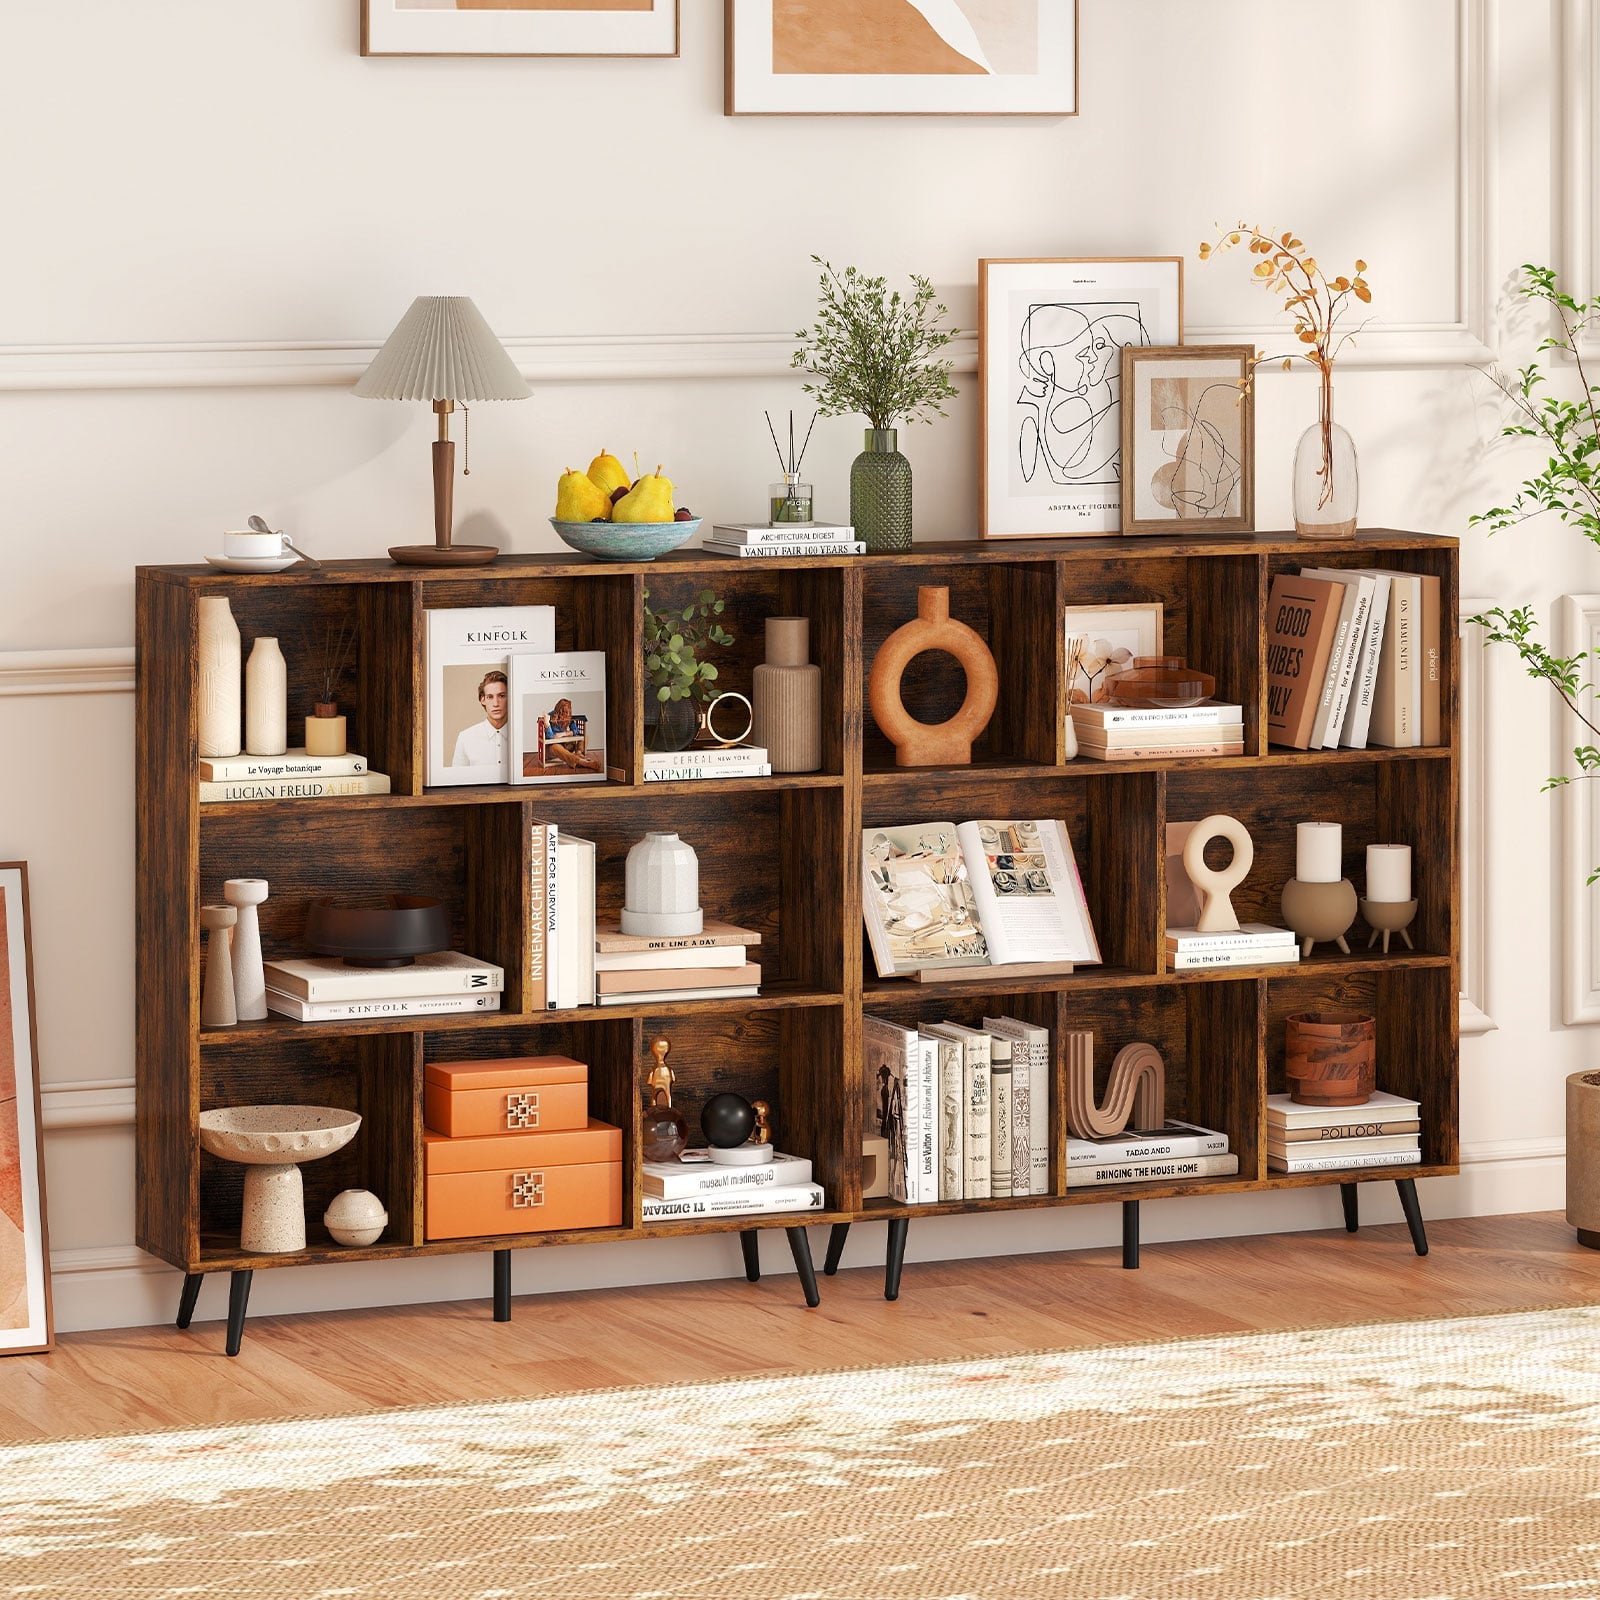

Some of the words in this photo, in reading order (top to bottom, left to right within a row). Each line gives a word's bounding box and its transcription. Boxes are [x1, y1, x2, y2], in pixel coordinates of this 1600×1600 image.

[760, 532, 810, 542] ARCHITECTURAL
[812, 532, 835, 540] DIGEST
[744, 545, 780, 557] VANITY
[781, 544, 802, 556] FAIR
[803, 544, 818, 555] 100
[819, 544, 848, 554] YEARS
[1400, 599, 1408, 613] ON
[1276, 605, 1312, 638] GOOD
[467, 630, 528, 642] KINFOLK
[1347, 627, 1360, 669] sustainable
[1355, 597, 1367, 626] lifestyle
[1400, 618, 1408, 672] IMMUNITY
[1362, 676, 1373, 707] DREAM
[1372, 619, 1381, 648] AWAKE
[1428, 648, 1438, 681] spherical
[540, 669, 586, 679] KINFOLK
[1324, 689, 1334, 707] THIS
[1332, 647, 1343, 671] GOOD
[1268, 685, 1293, 717] NLY
[673, 754, 712, 765] CEREAL
[248, 766, 257, 775] Le
[257, 765, 284, 775] Voyage
[285, 763, 322, 773] botanique
[225, 785, 275, 800] LUCIAN
[280, 783, 323, 798] FREUD
[326, 784, 335, 795] A
[340, 781, 363, 795] LIFE
[531, 825, 544, 981] INNENARCHITEKTUR
[648, 941, 666, 949] ONE
[669, 940, 688, 948] LINE
[699, 938, 716, 946] DAY
[1186, 955, 1200, 963] ride
[1202, 954, 1214, 963] the
[1215, 953, 1231, 962] bike
[348, 1003, 408, 1014] KINFOLK
[1320, 1123, 1383, 1140] POLLOCK
[922, 1133, 932, 1156] Vuitton
[1125, 1147, 1150, 1157] TADAO
[1150, 1146, 1171, 1155] ANDO
[922, 1156, 932, 1175] Louis
[1096, 1166, 1132, 1180] BRINGING
[1134, 1166, 1149, 1177] THE
[1150, 1164, 1175, 1176] HOUSE
[1177, 1163, 1198, 1174] HOME
[1318, 1160, 1337, 1169] NEW
[1339, 1158, 1361, 1168] LOOK
